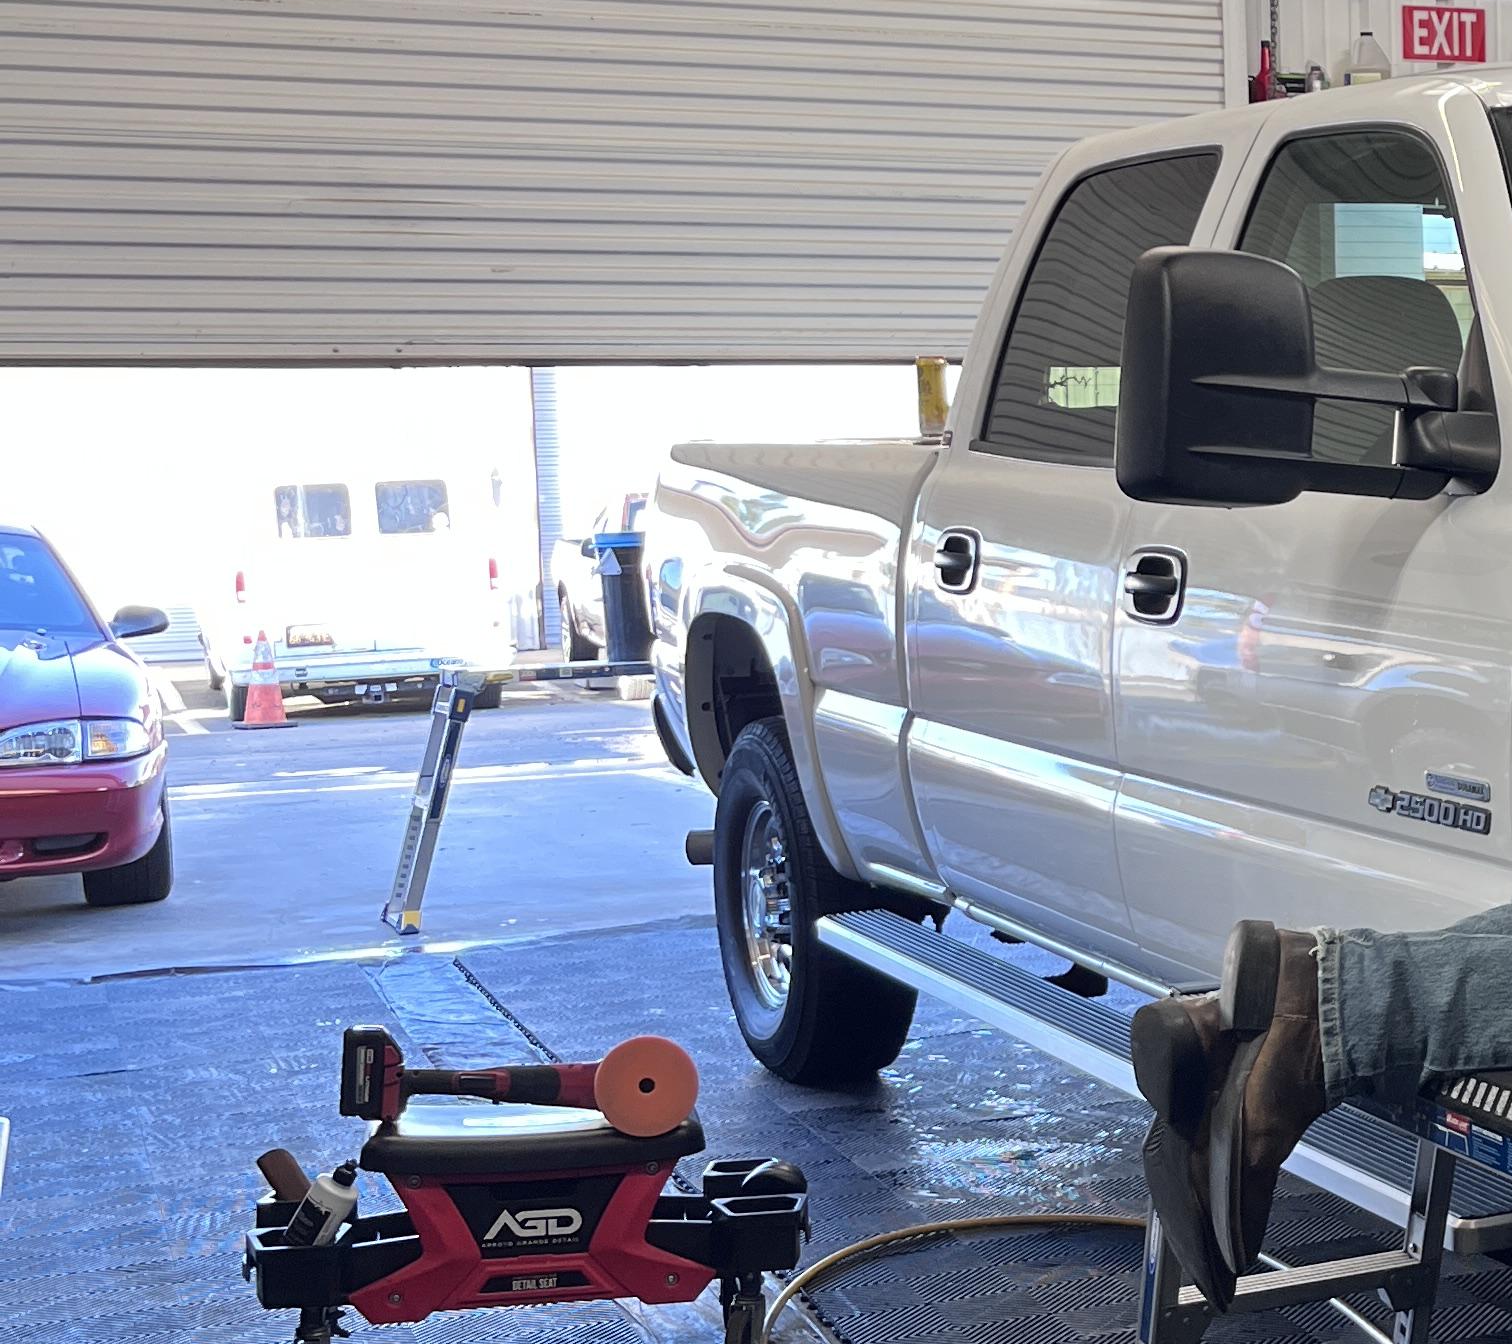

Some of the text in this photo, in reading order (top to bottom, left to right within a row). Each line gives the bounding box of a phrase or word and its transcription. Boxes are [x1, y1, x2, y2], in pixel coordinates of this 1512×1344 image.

[1412, 9, 1477, 57] EXIT
[1396, 792, 1486, 830] 2500 HD
[483, 1208, 583, 1241] AGD
[512, 1277, 558, 1291] DETAIL SEAT
